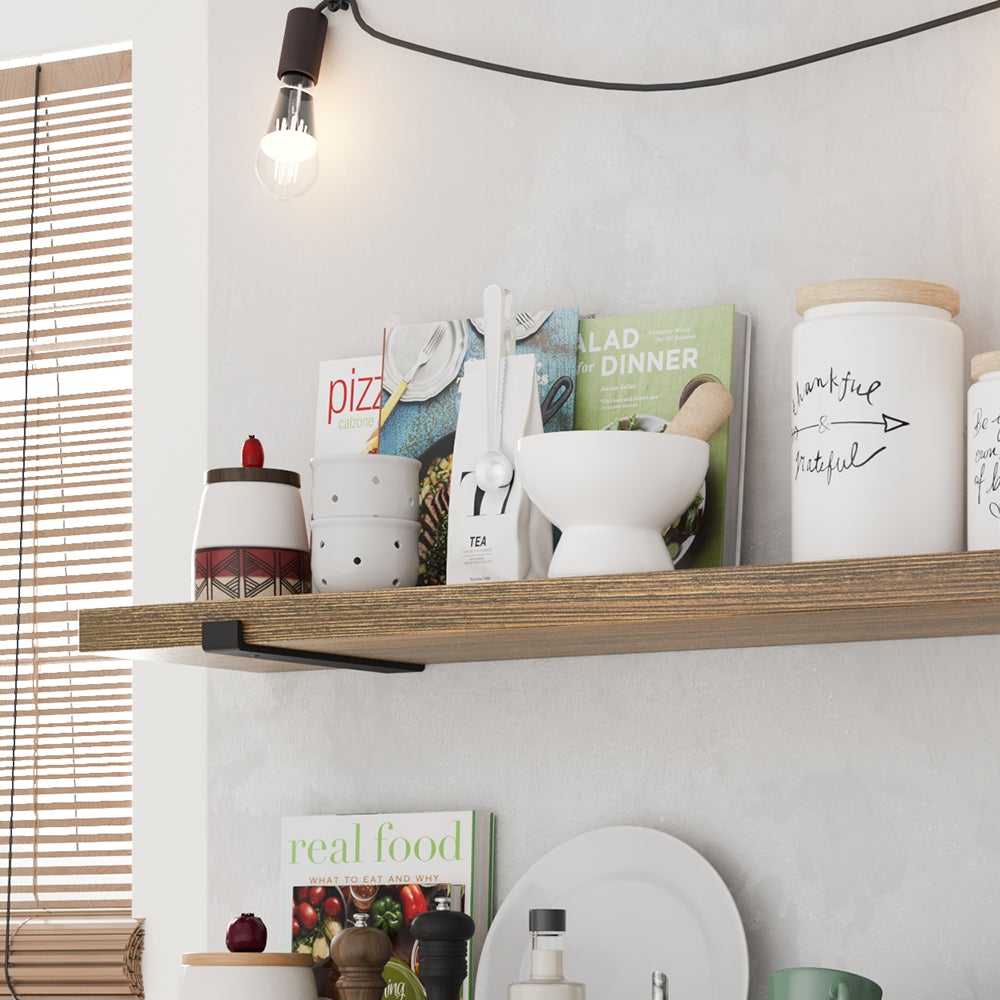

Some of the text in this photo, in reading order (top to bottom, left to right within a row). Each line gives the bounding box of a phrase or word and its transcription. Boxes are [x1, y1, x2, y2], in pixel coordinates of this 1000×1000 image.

[601, 347, 698, 377] DINNER
[338, 416, 375, 430] calzone
[470, 536, 487, 548] TEA
[288, 818, 464, 865] real food
[309, 874, 440, 885] WHAT TO EAT AND WHY
